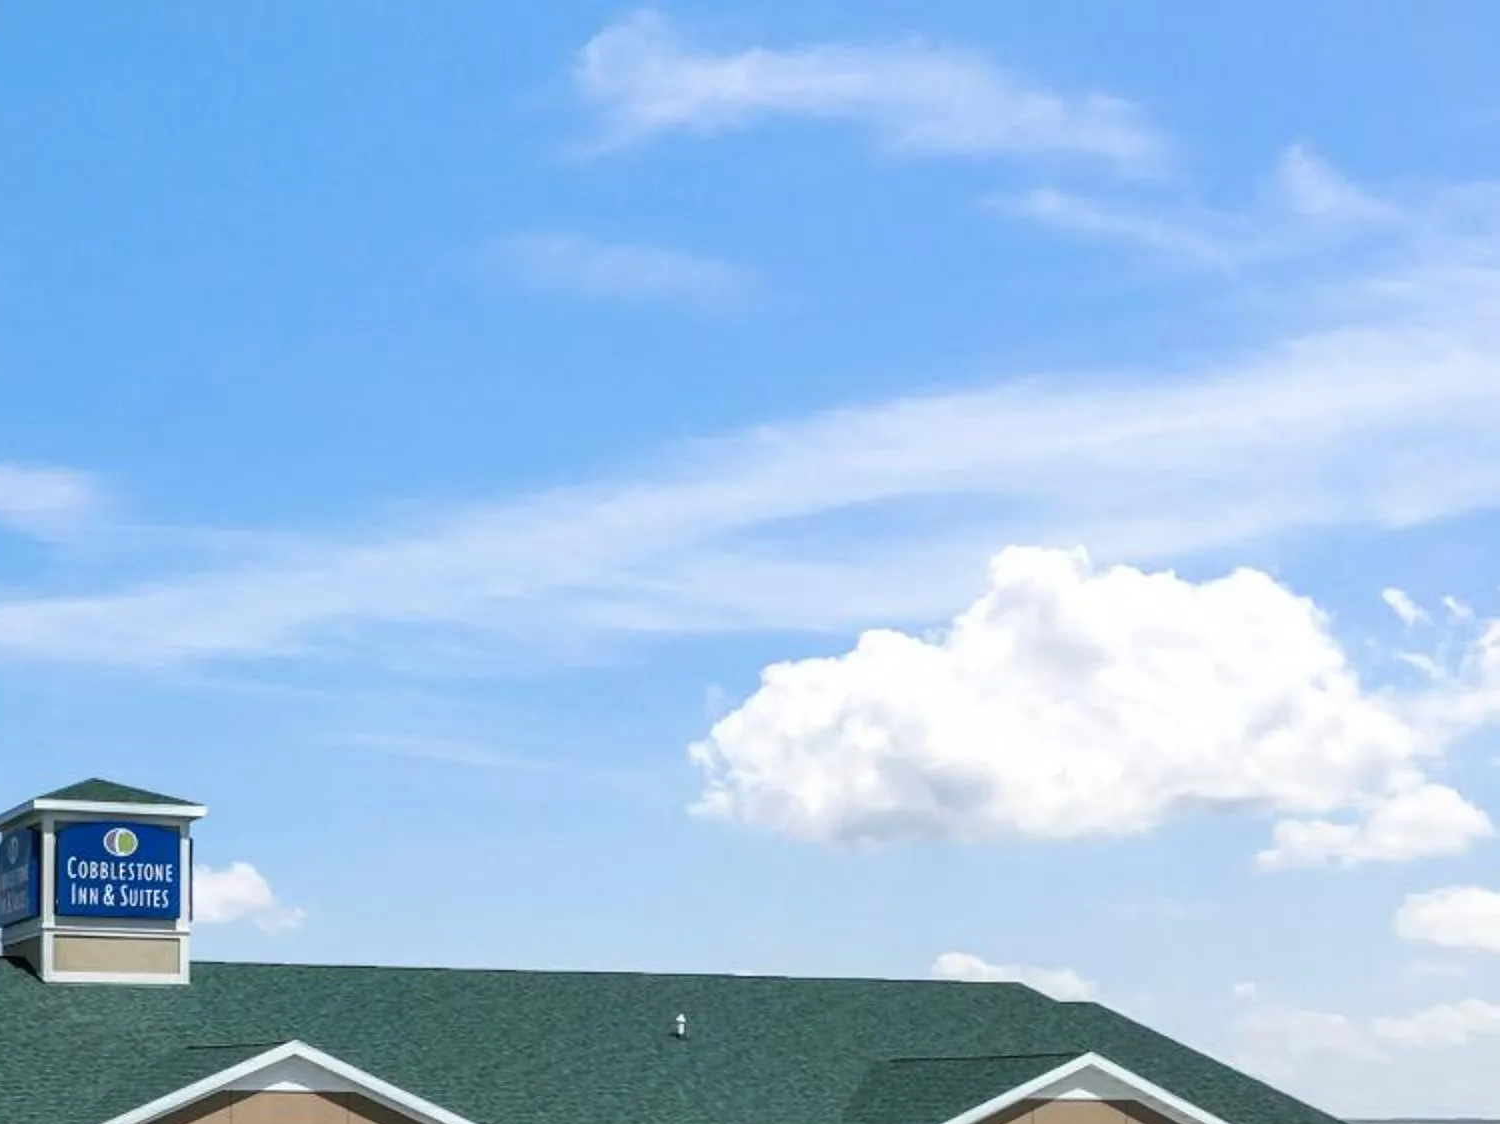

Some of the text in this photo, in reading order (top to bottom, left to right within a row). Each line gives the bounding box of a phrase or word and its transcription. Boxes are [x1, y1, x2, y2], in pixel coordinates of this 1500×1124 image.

[67, 856, 173, 882] COBBLESTONE
[71, 882, 169, 908] INN & SUITES
